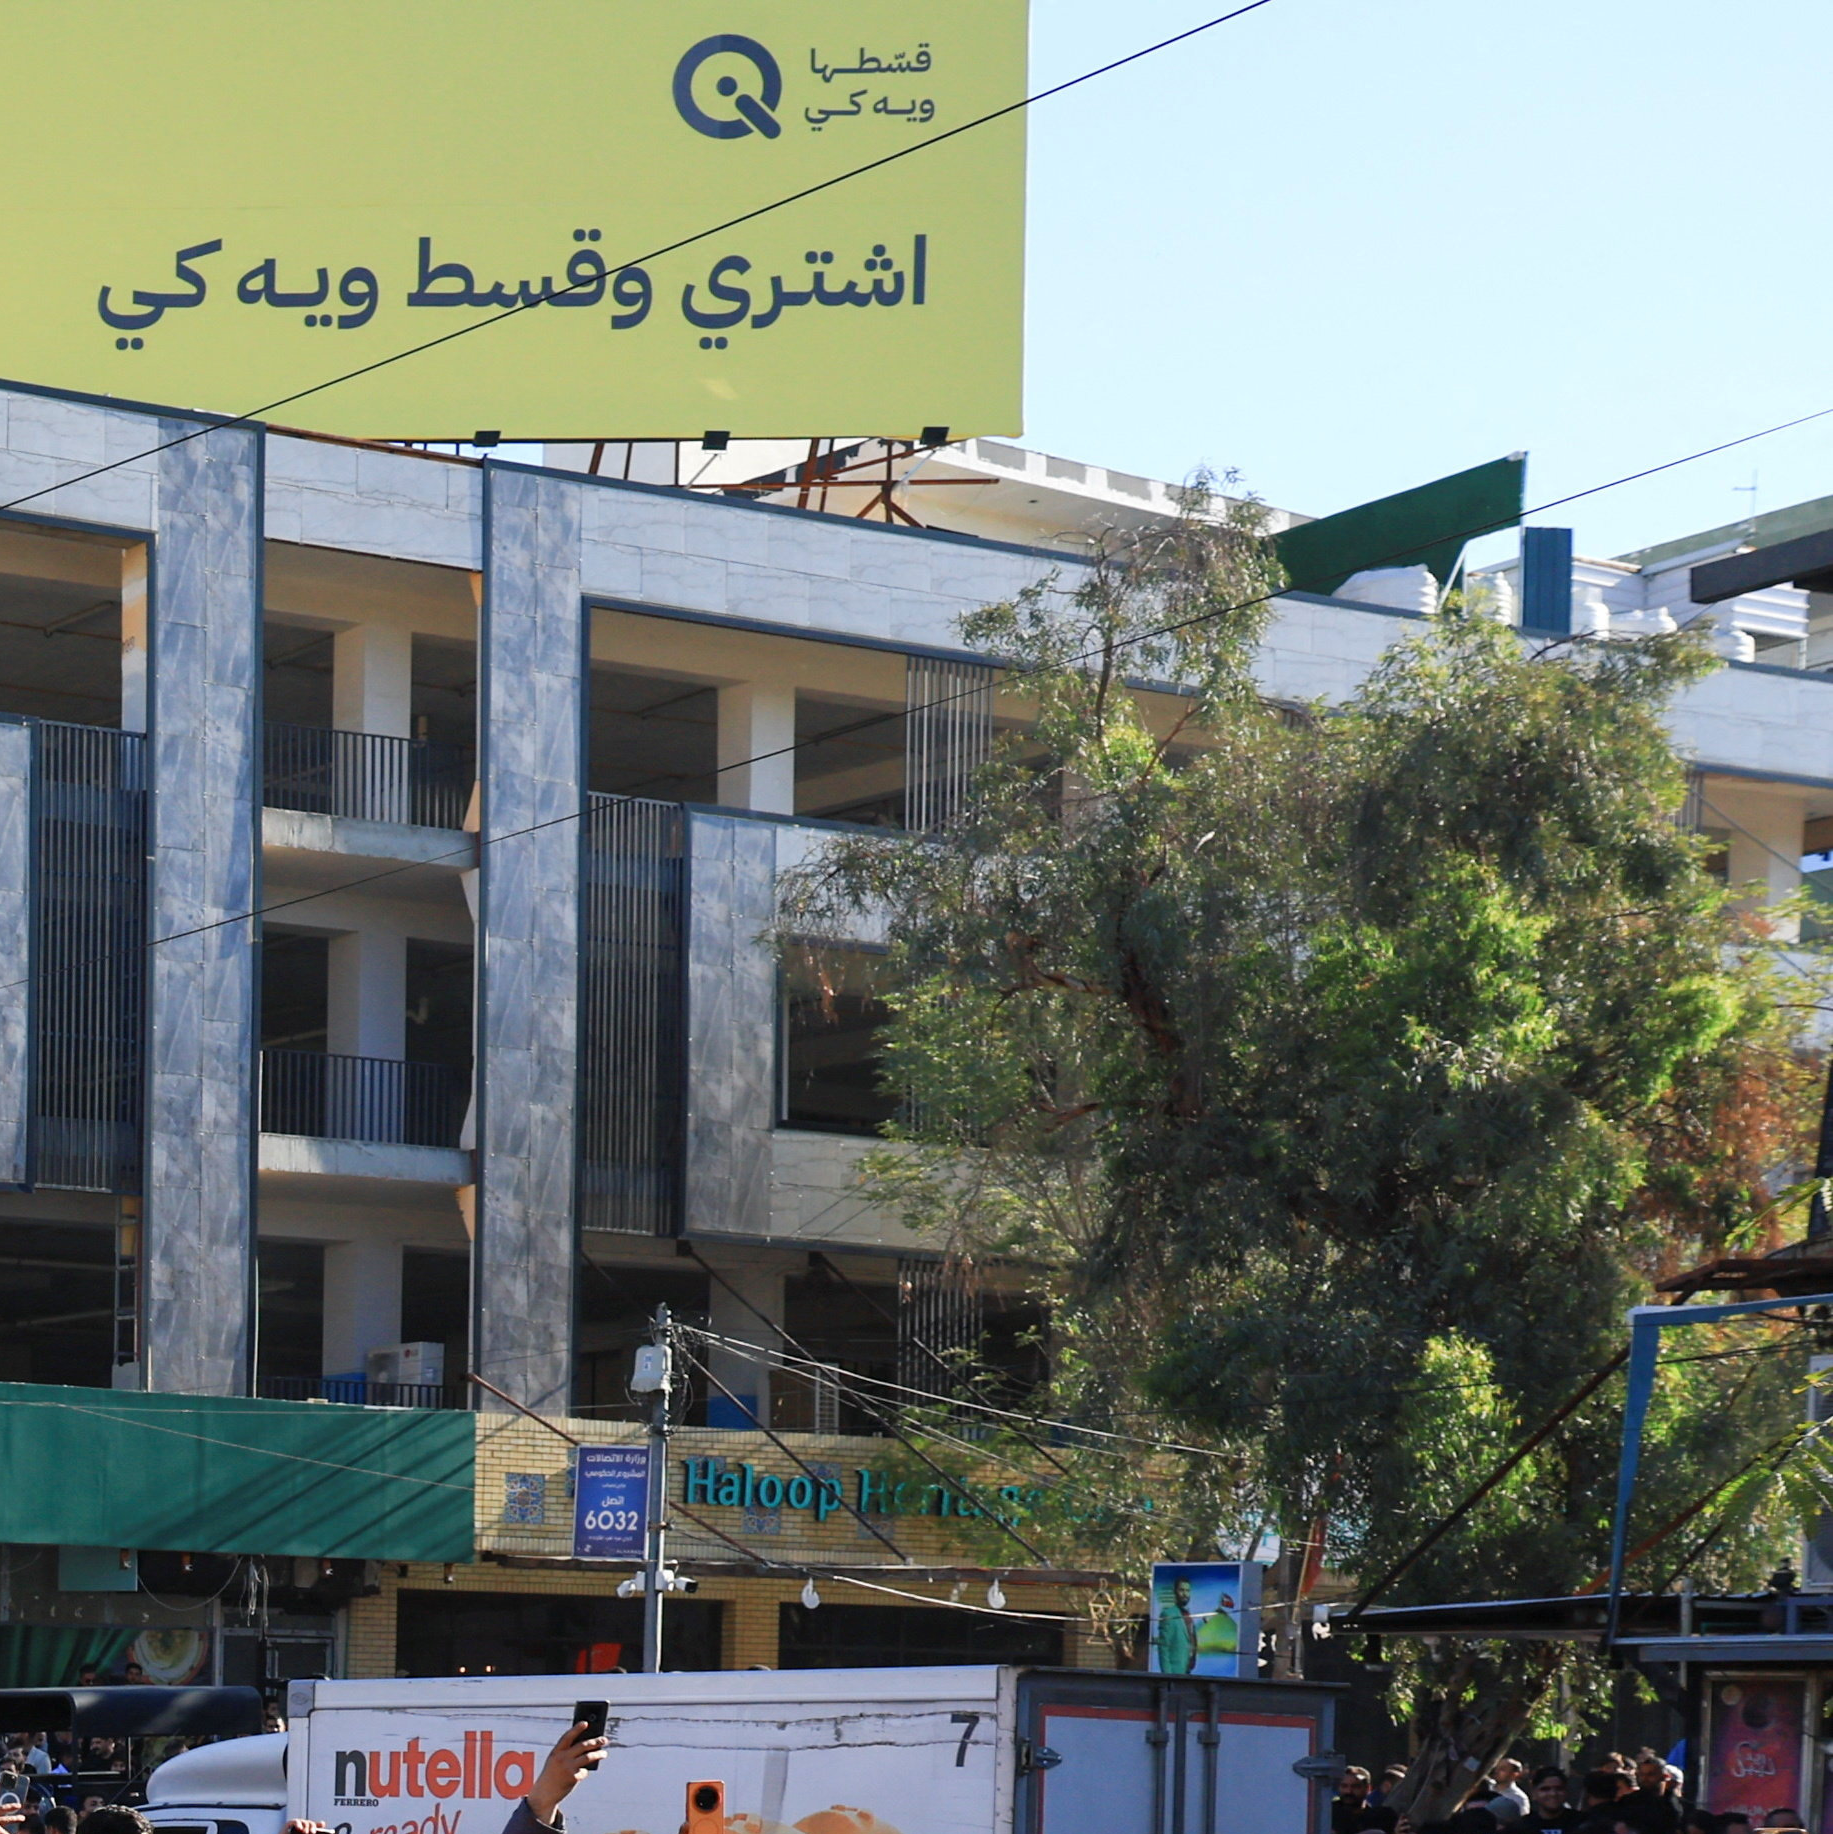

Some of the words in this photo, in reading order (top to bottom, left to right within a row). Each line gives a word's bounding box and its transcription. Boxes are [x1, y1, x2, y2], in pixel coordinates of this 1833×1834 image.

[803, 87, 867, 131] كي
[873, 90, 936, 124] ويه
[96, 238, 223, 351] كي
[235, 255, 380, 330] ويه
[406, 227, 653, 330] وقسط
[679, 233, 928, 351] اشتري
[584, 1510, 639, 1532] 6032
[684, 1458, 843, 1523] Haloop
[334, 1730, 536, 1800] nutella
[950, 1713, 981, 1768] 7
[333, 1798, 380, 1807] FERRERO
